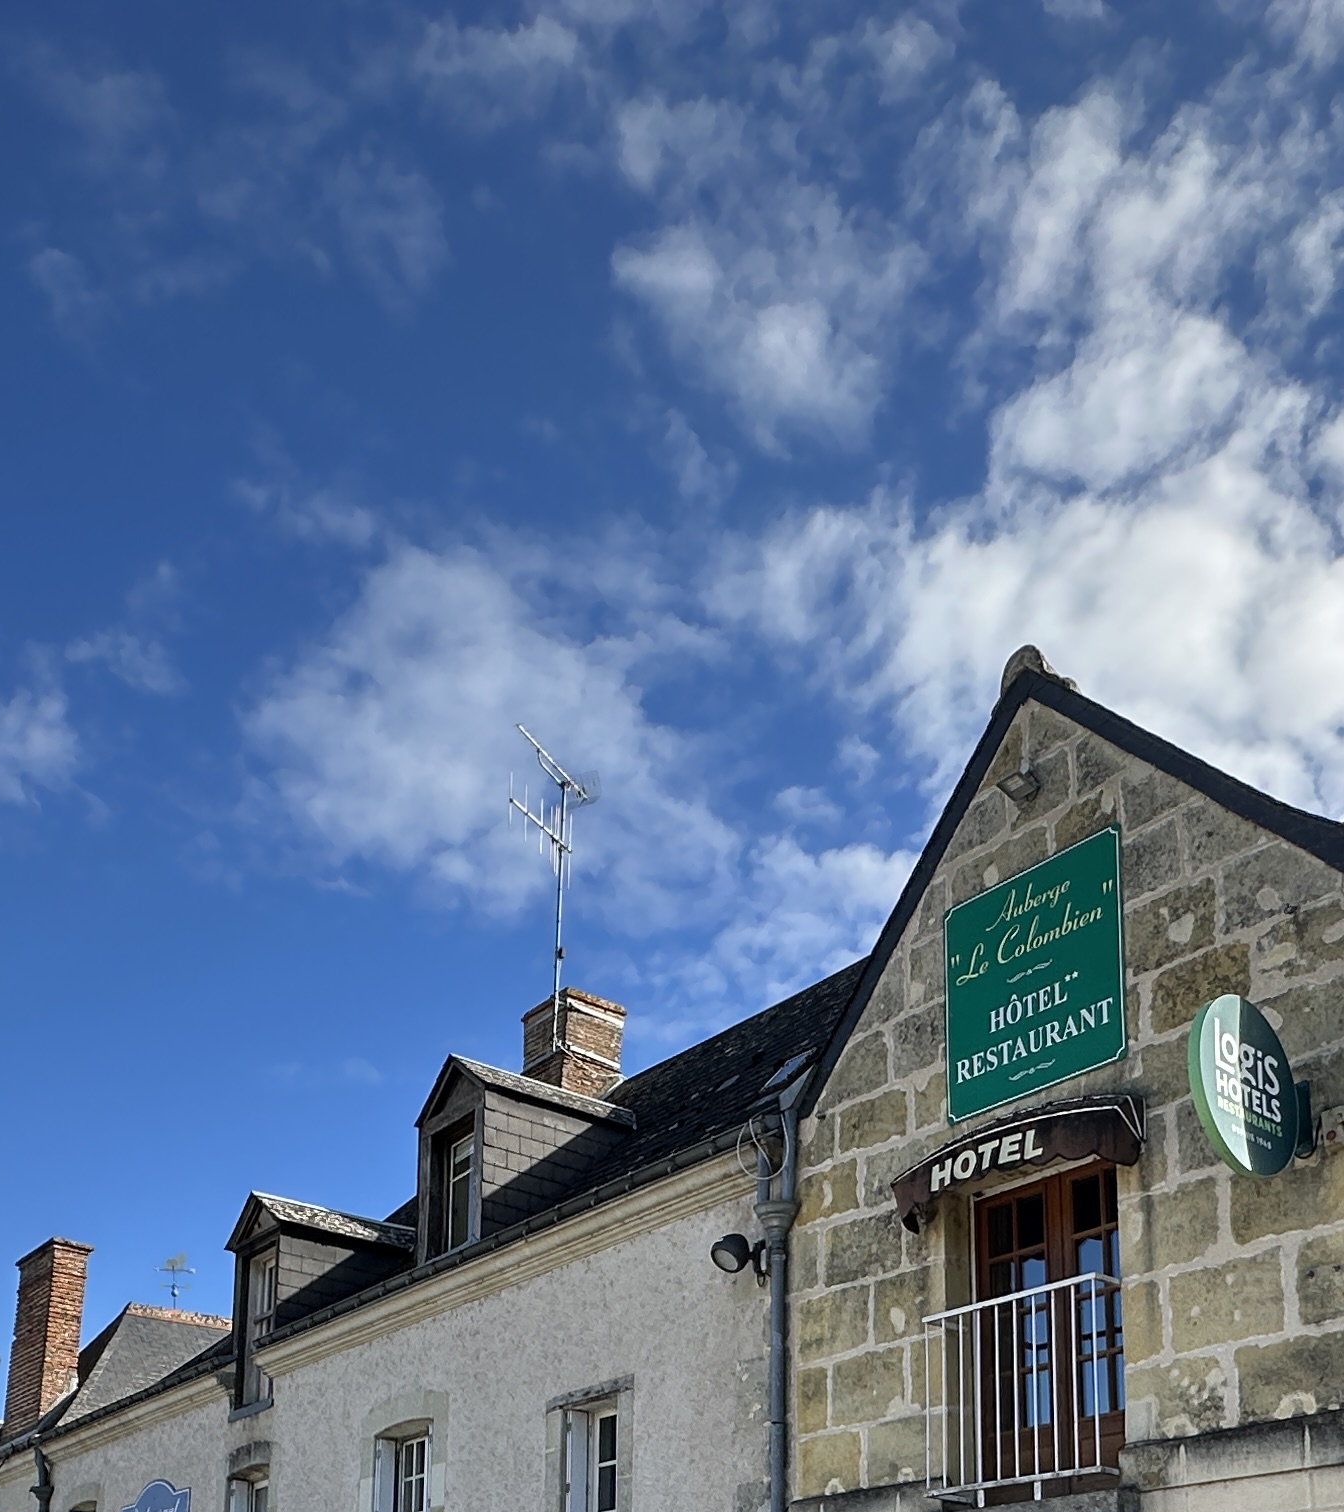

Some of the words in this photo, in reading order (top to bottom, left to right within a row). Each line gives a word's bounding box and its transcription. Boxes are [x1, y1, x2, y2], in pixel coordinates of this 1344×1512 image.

[985, 880, 1071, 932] Auberge
[955, 996, 1114, 1085] RESTAURANT
[1215, 1068, 1283, 1124] HOTELS
[1216, 1094, 1284, 1138] RESTAURANTS
[929, 1128, 1044, 1193] HOTEL
